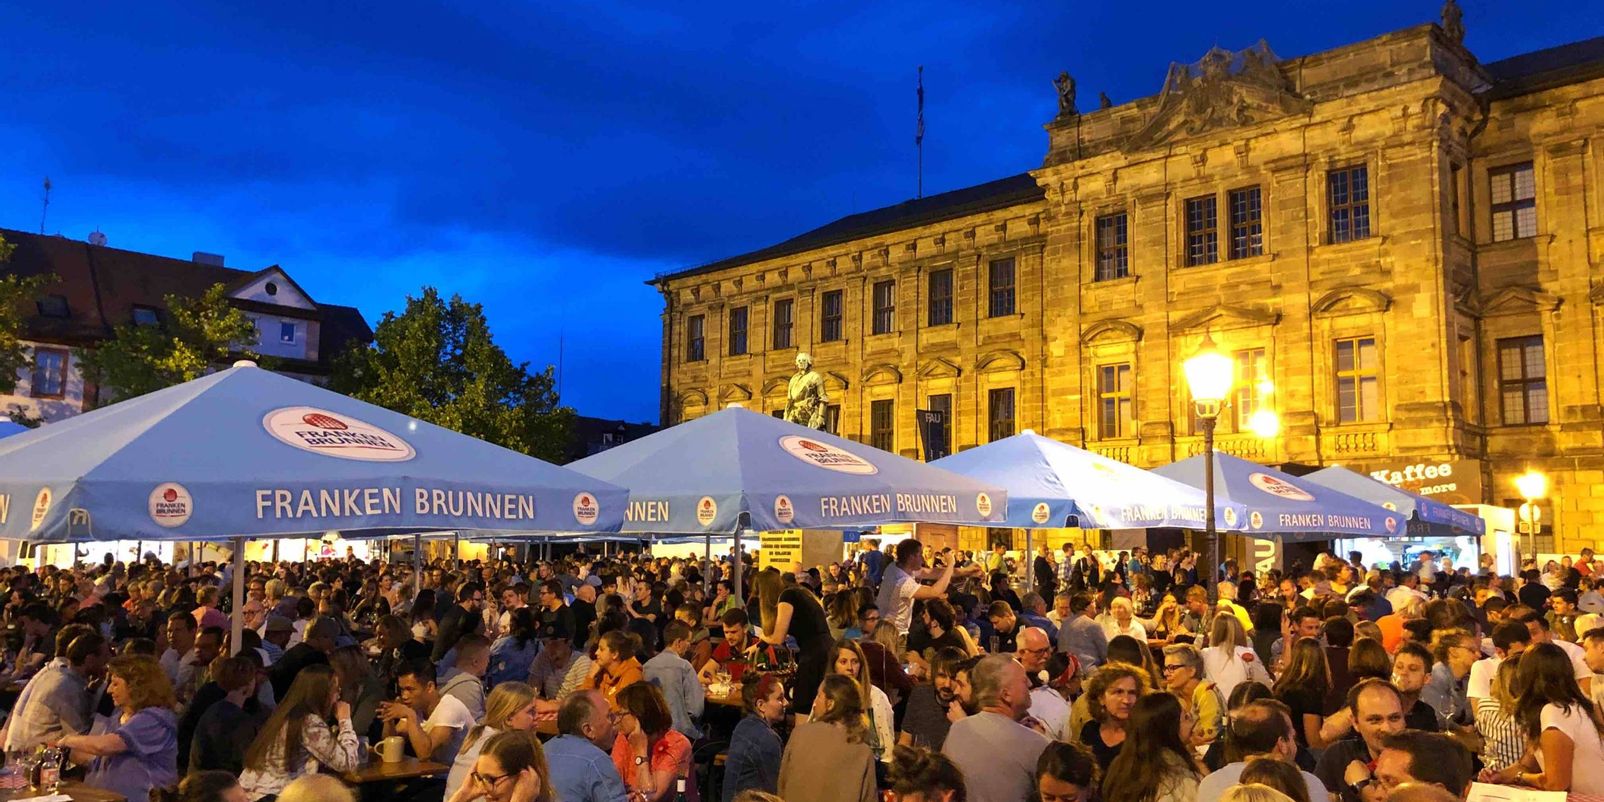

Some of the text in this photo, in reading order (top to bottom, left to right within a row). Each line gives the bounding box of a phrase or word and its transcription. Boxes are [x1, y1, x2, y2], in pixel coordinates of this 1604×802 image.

[925, 412, 941, 423] FAU
[295, 430, 388, 443] FRANKEN
[304, 437, 396, 448] BRUNNEN
[1370, 463, 1453, 485] Kaffee
[1420, 483, 1456, 495] more
[255, 487, 535, 519] FRANKEN BRUNNEN
[820, 494, 891, 518] FRANKEN
[896, 493, 957, 513] BRUNNEN
[1279, 514, 1371, 530] FRANKEN BRUNNEN
